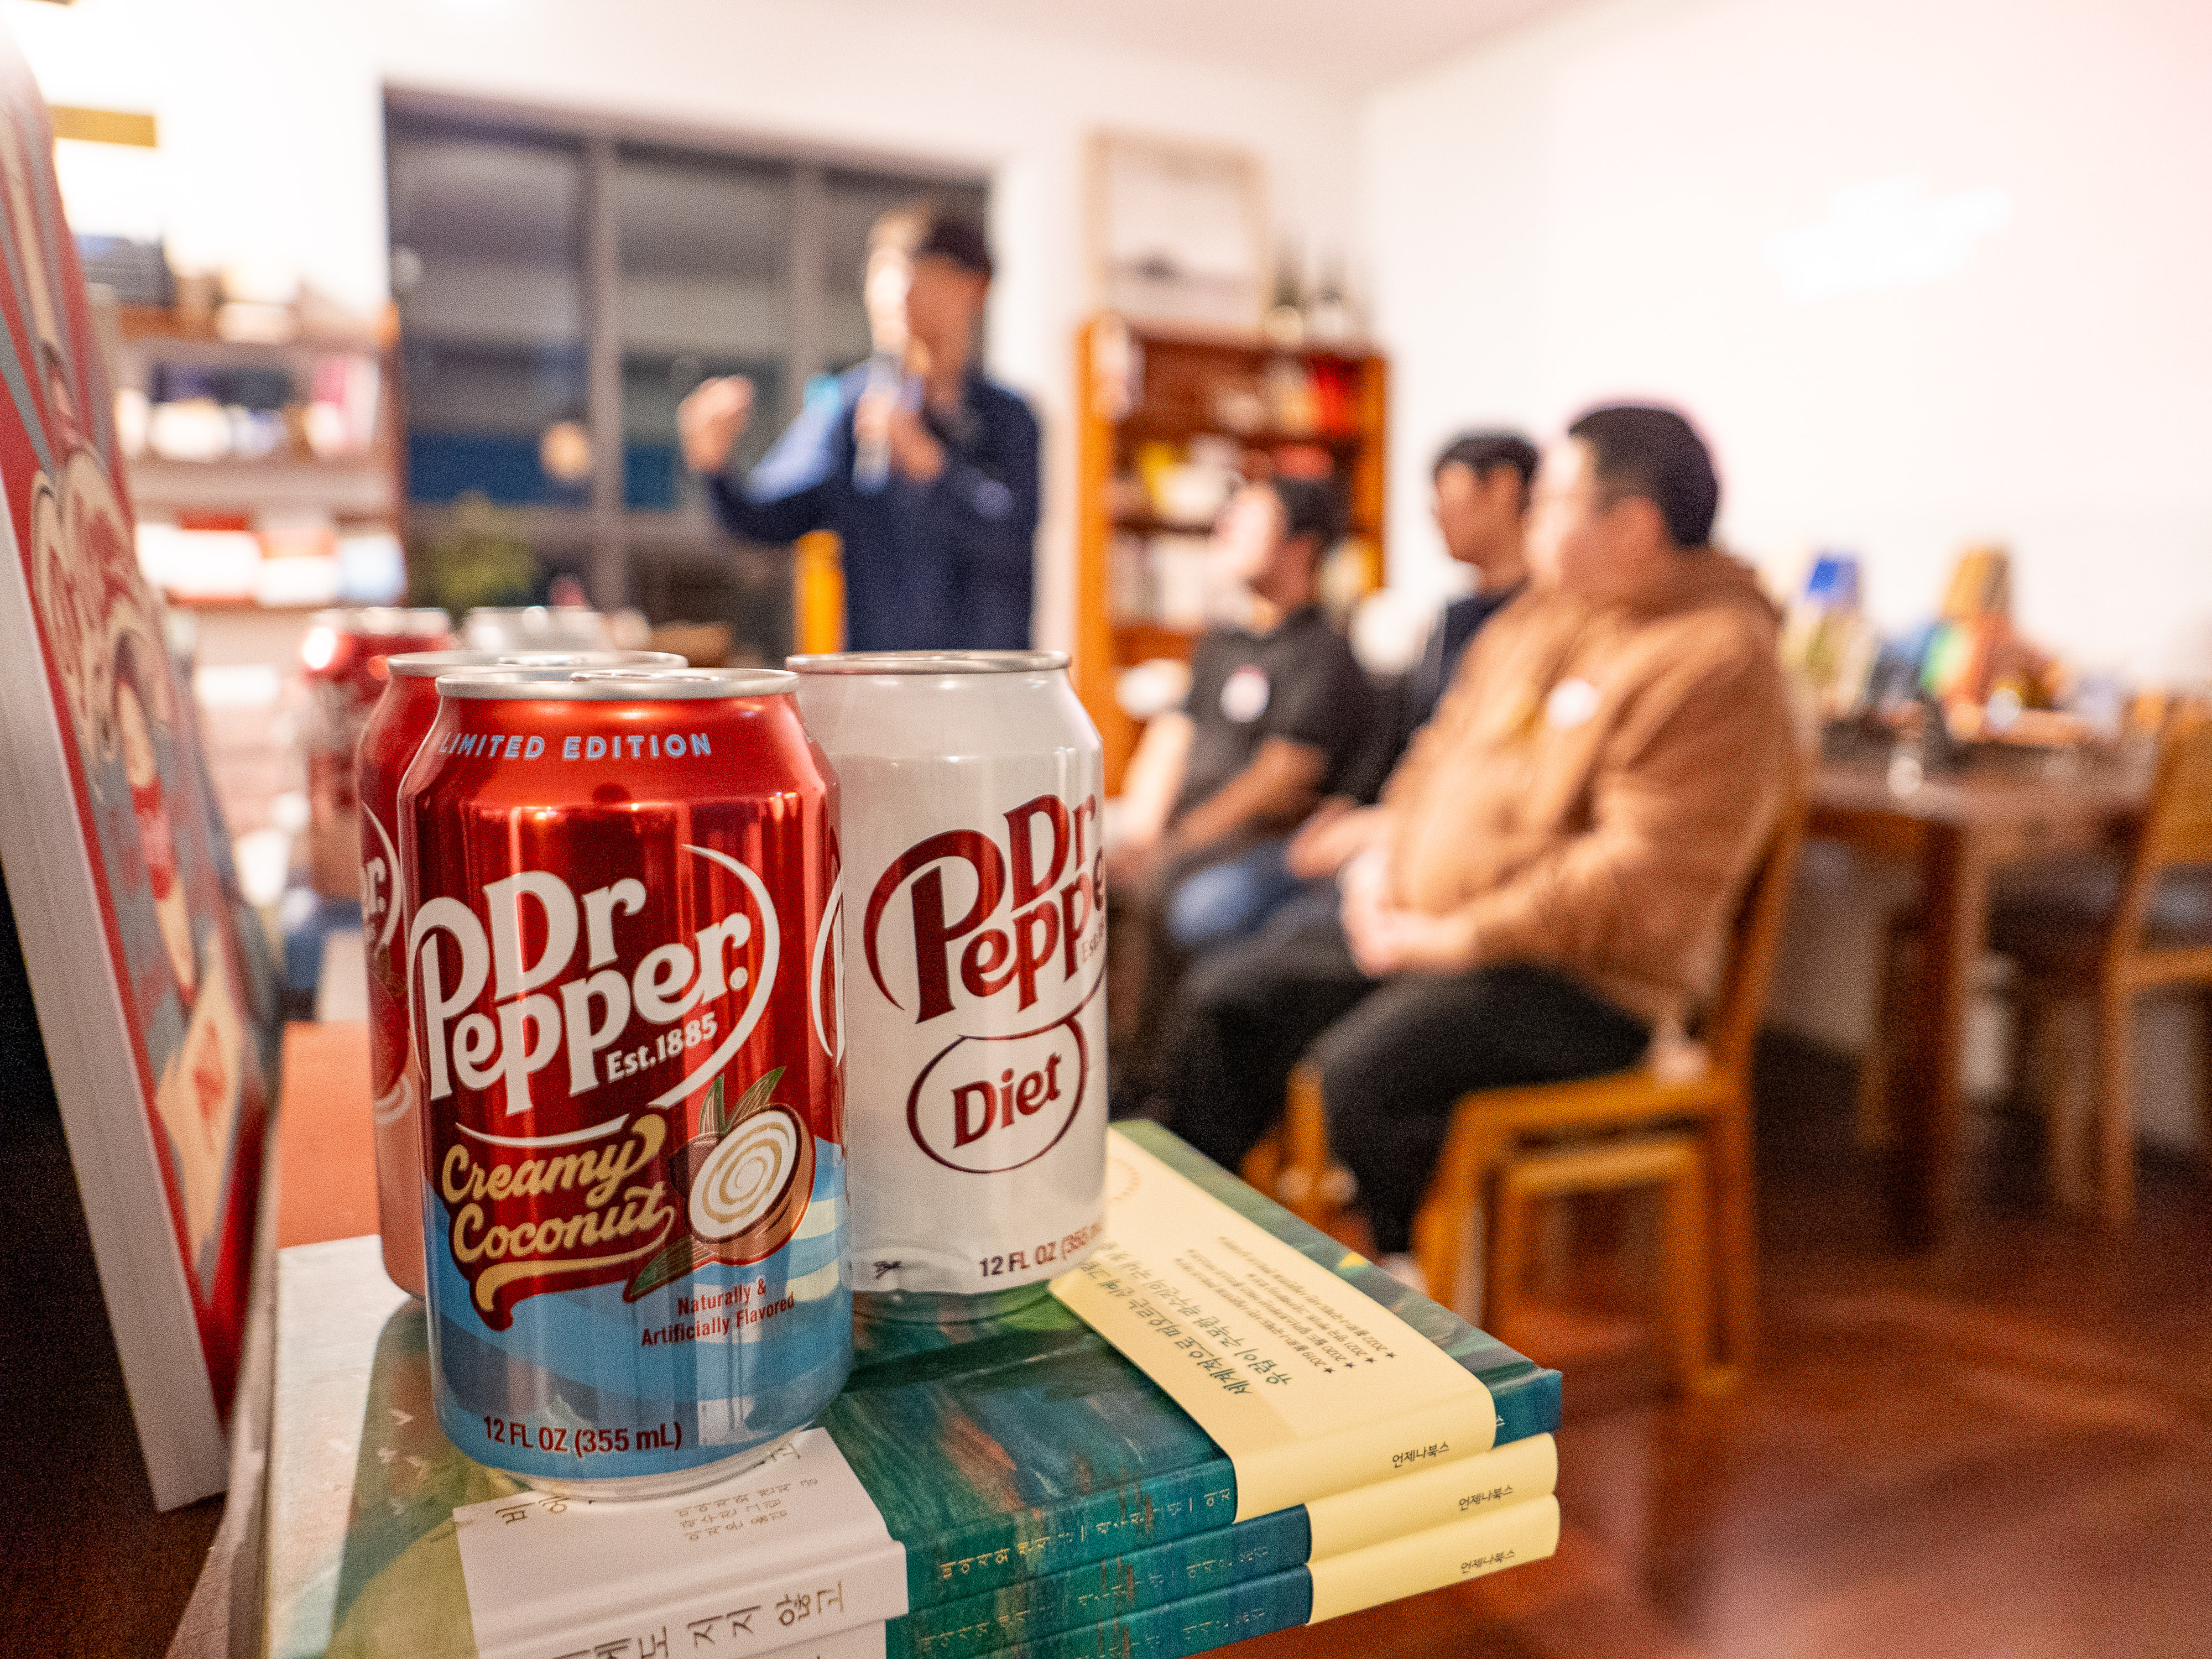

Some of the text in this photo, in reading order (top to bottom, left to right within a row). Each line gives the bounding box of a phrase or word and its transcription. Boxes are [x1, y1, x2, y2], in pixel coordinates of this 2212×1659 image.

[440, 732, 712, 760] LIMITED EDITION
[1004, 794, 1097, 912] Dr
[483, 870, 646, 1001] Dr
[951, 1052, 1061, 1149] Diet
[441, 1114, 666, 1209] Creamy
[452, 1181, 676, 1264] Coconut
[979, 1255, 1004, 1277] 12
[1008, 1250, 1031, 1272] FL
[1035, 1240, 1057, 1265] OZ
[678, 1277, 767, 1317] Naturally &
[641, 1292, 795, 1347] Artificially Flavored
[1301, 1351, 1327, 1368] 2019
[1321, 1345, 1348, 1362] 2020
[1343, 1342, 1368, 1357] 2021
[1361, 1336, 1389, 1352] 2022
[1173, 1336, 1251, 1395] 세계적으로
[1233, 1348, 1292, 1385] 유럽이
[484, 1416, 682, 1458] 12 FL OZ (355 mL)
[1392, 1441, 1449, 1469] 언제나북스
[1458, 1485, 1514, 1512] 언제나북스
[1460, 1548, 1516, 1574] 언제나북스
[687, 1605, 761, 1648] 지지
[776, 1580, 844, 1627] 않고
